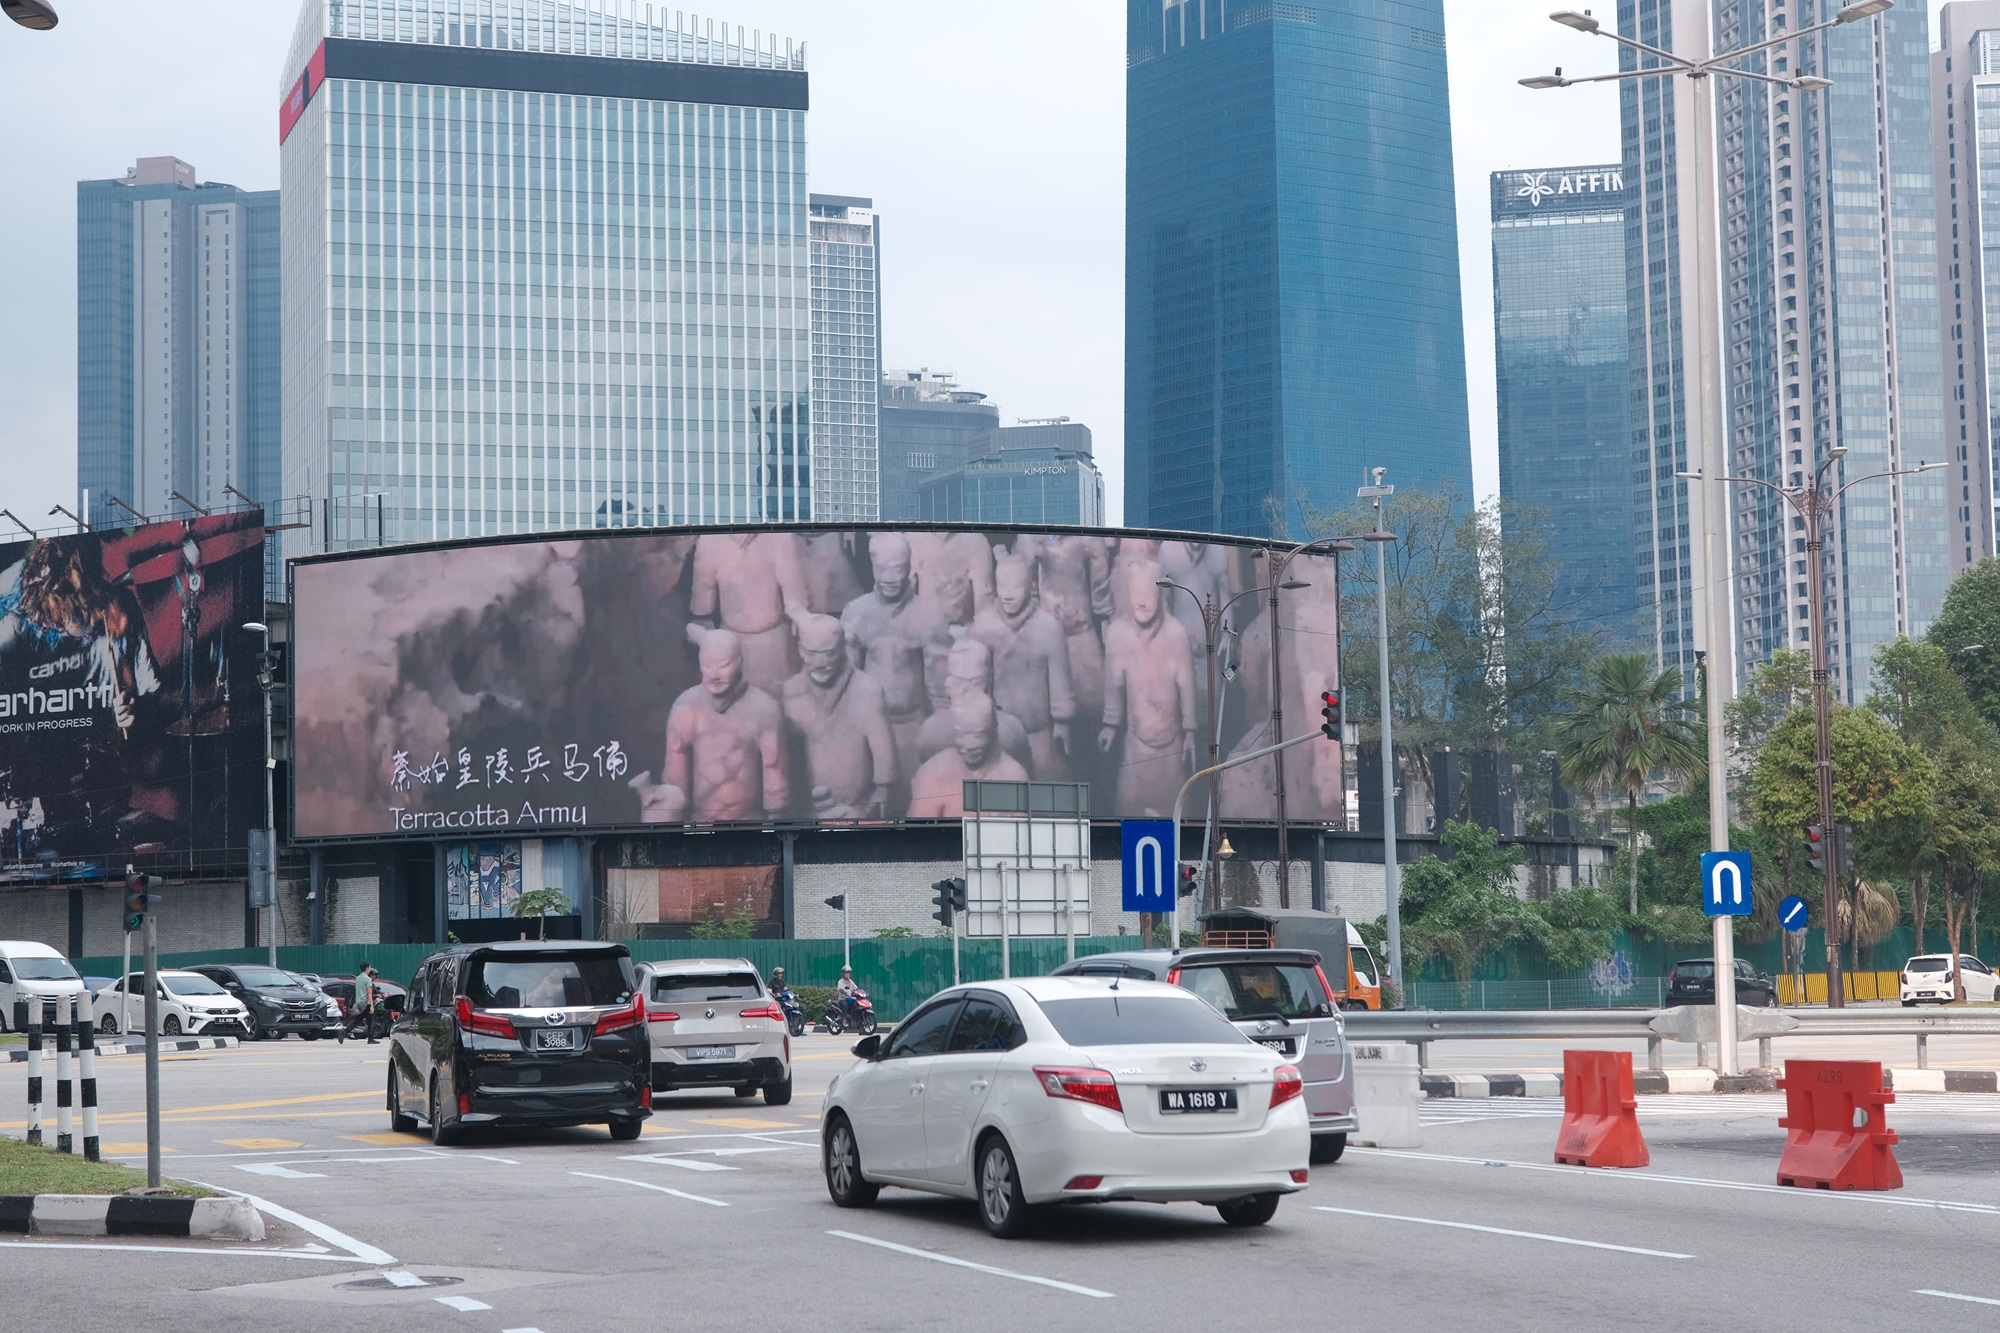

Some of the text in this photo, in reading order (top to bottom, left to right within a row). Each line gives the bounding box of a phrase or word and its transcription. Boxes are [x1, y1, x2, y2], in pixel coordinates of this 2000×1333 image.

[1557, 172, 1624, 195] AFFIN
[1024, 466, 1066, 476] KIMPTON
[25, 721, 35, 731] IN
[37, 717, 93, 731] PROGRESS
[391, 741, 628, 793] 秦始皇陵兵马俑
[389, 801, 587, 831] Terracotta Army
[546, 1031, 564, 1039] CEP
[544, 1038, 567, 1048] 3988
[711, 1047, 727, 1056] 5971
[1167, 1091, 1228, 1109] WA 1618 Y
